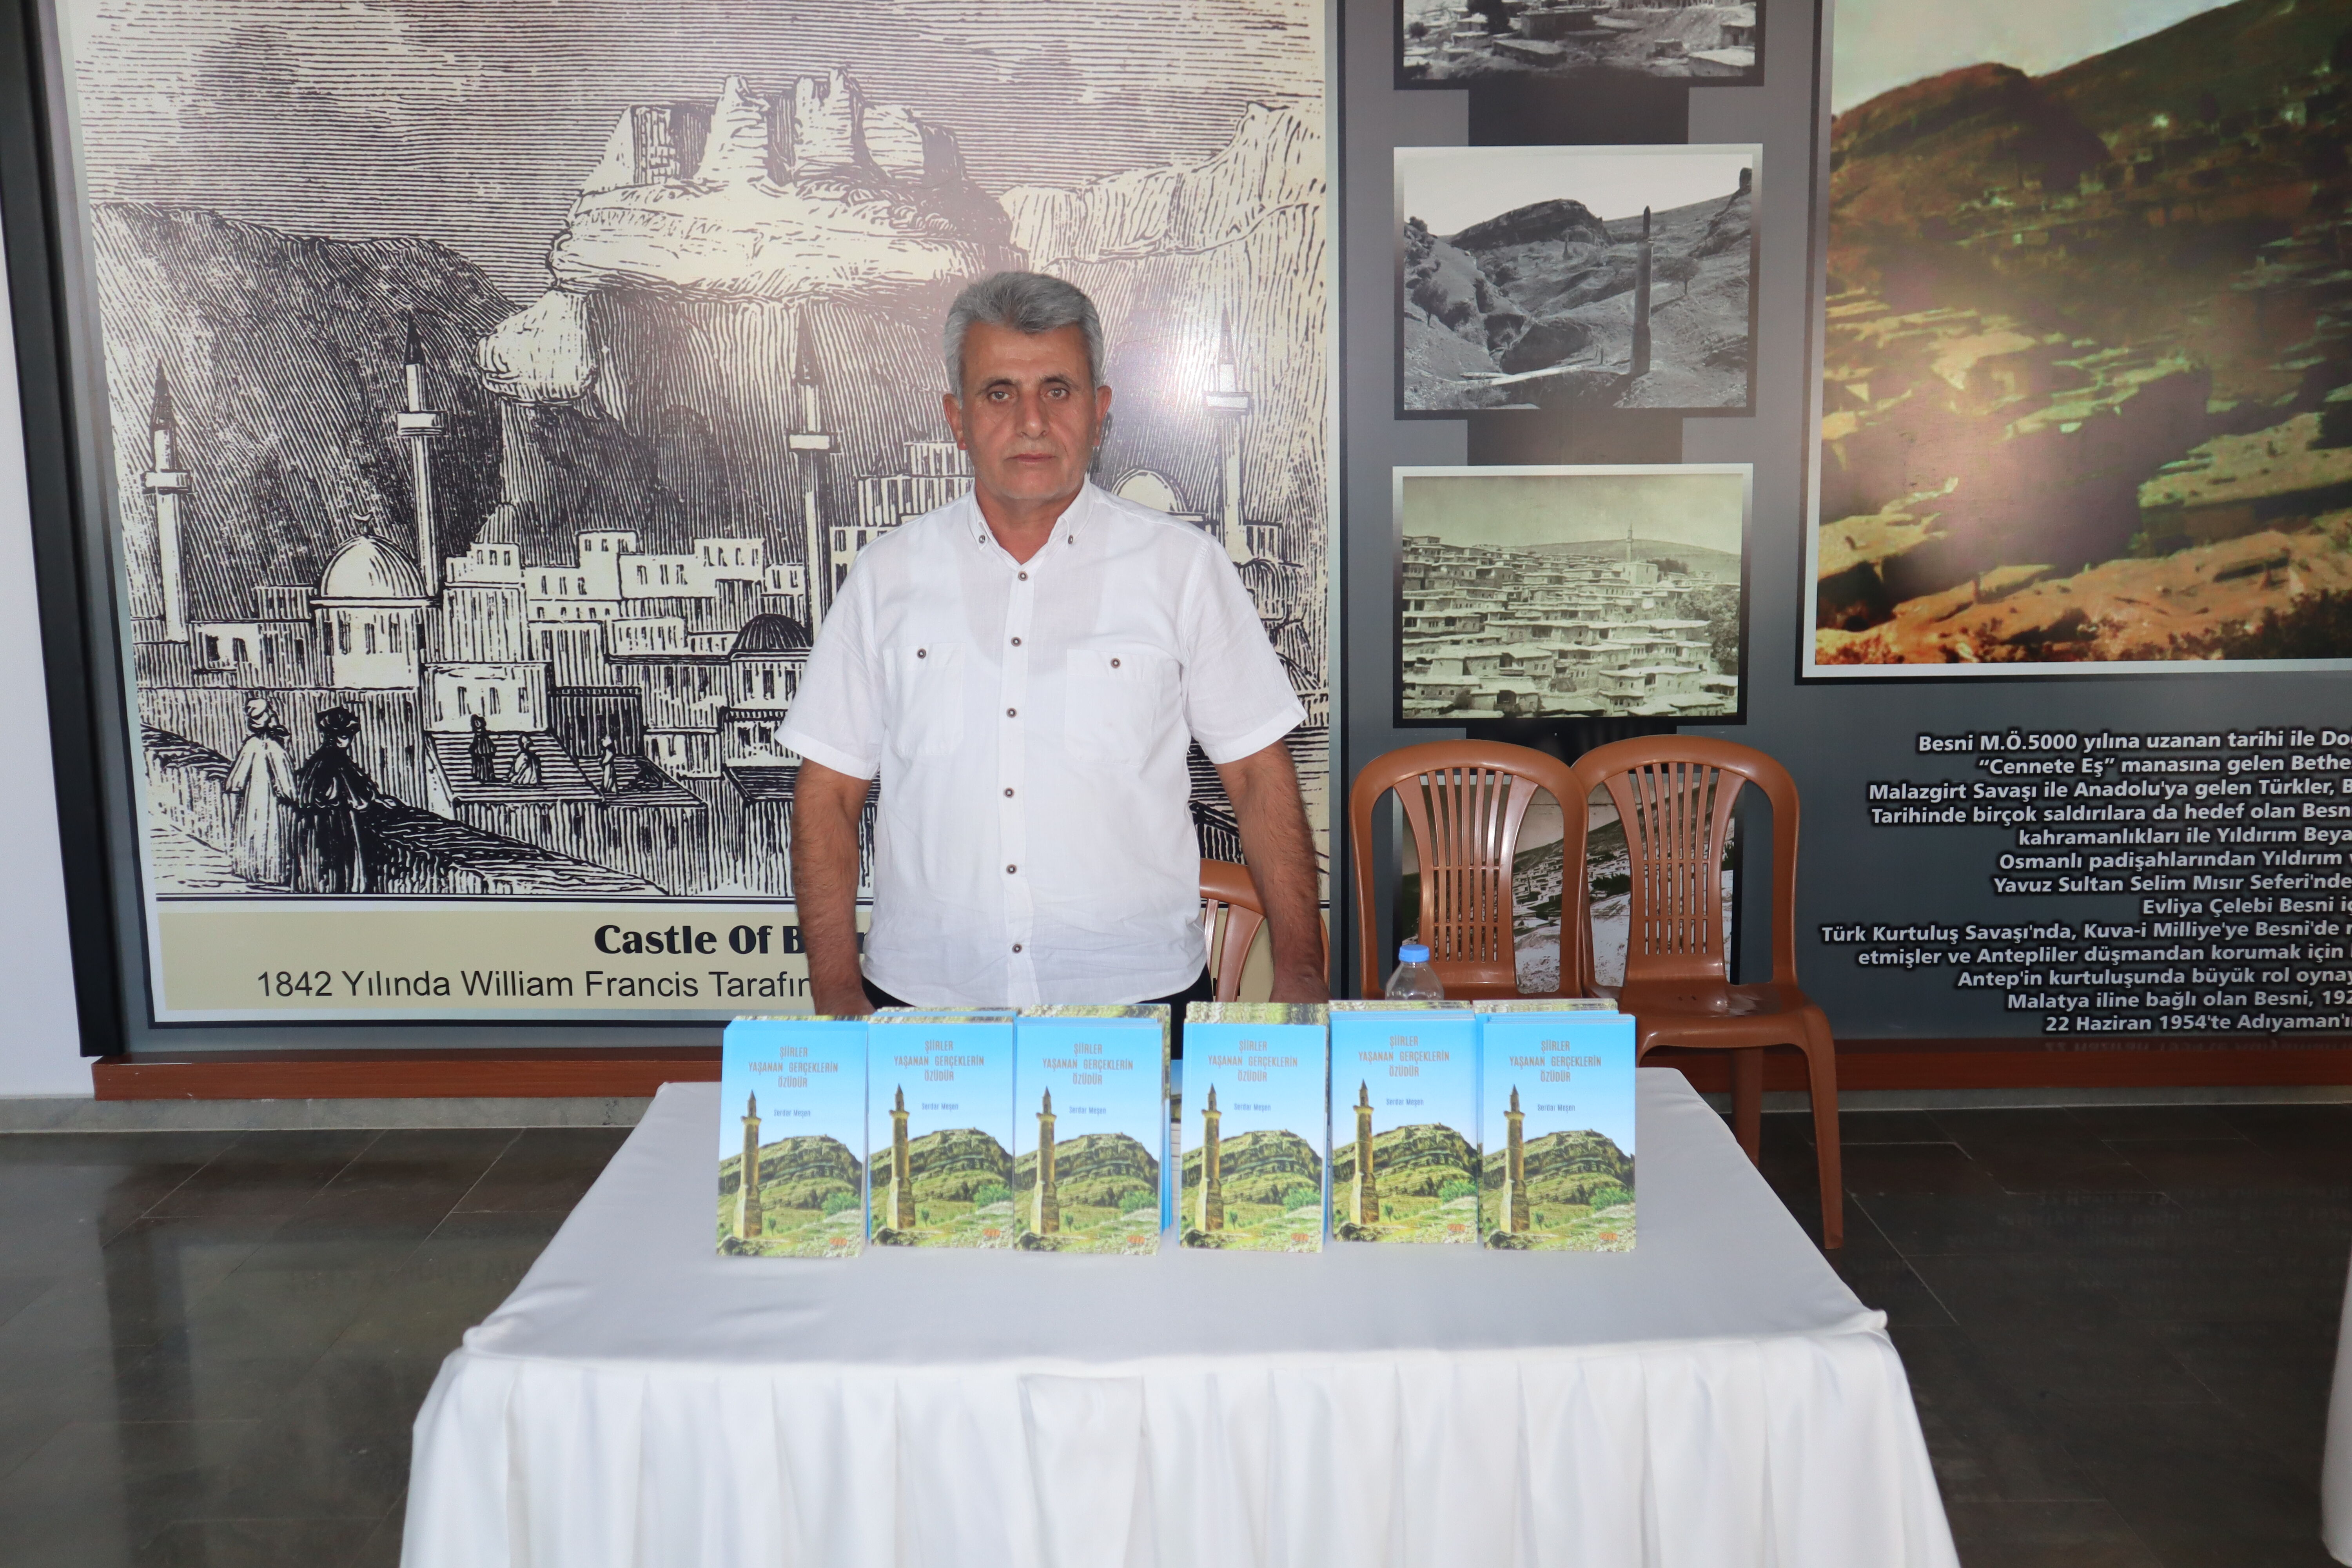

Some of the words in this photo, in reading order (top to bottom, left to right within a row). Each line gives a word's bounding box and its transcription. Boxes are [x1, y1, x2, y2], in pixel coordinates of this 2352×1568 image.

[1919, 735, 1973, 751] Besni
[1980, 730, 2077, 750] M.Ö.5000
[2084, 733, 2140, 753] yılına
[2147, 736, 2221, 748] uzanan
[2227, 730, 2283, 747] tarihi
[2291, 730, 2315, 746] ile
[2322, 731, 2352, 749] Do
[2122, 760, 2220, 772] manasına
[2227, 755, 2284, 775] gelen
[2291, 754, 2352, 771] Bethe
[1869, 783, 1967, 803] Malazgirt
[1973, 783, 2036, 802] Savaşı
[2044, 781, 2068, 797] ile
[2195, 779, 2251, 799] gelen
[2259, 778, 2334, 795] Türkler,
[1871, 807, 1966, 823] Tarihinde
[1973, 806, 2036, 826] birçok
[2044, 804, 2145, 821] saldırılara
[2152, 804, 2177, 820] da
[2185, 803, 2245, 819] hedef
[2251, 802, 2295, 818] olan
[2303, 803, 2352, 818] Besn
[2019, 828, 2179, 845] kahramanlıkları
[2187, 827, 2210, 843] ile
[2217, 826, 2296, 842] Yıldırım
[2000, 853, 2082, 869] Osmanlı
[2089, 851, 2255, 872] padişahlarından
[2262, 850, 2342, 865] Yıldırım
[1994, 878, 2052, 892] Yavuz
[2059, 876, 2123, 892] Sultan
[2131, 875, 2185, 891] Selim
[2193, 875, 2244, 890] Mısır
[2143, 898, 2202, 917] Evliya
[2210, 897, 2272, 917] Çelebi
[2280, 897, 2334, 912] Besni
[594, 925, 717, 955] Castle
[728, 925, 773, 954] Of
[1822, 926, 1866, 941] Türk
[1873, 925, 1958, 944] Kurtuluş
[2084, 922, 2146, 938] Kuva-i
[1859, 949, 1942, 968] etmişler
[1948, 952, 1971, 963] ve
[1977, 947, 2078, 966] Antepliler
[2085, 945, 2204, 965] düşmandan
[2212, 944, 2301, 959] korumak
[2308, 943, 2343, 963] için
[257, 970, 333, 997] 1842
[341, 970, 451, 996] Yılında
[460, 970, 573, 997] William
[586, 971, 699, 997] Francis
[2050, 968, 2185, 988] kurtuluşunda
[2192, 967, 2254, 987] büyük
[2263, 967, 2289, 982] rol
[2008, 993, 2089, 1012] Malatya
[2097, 992, 2139, 1007] iline
[2147, 991, 2196, 1010] bağlı
[2203, 991, 2247, 1006] olan
[2255, 990, 2313, 1007] Besni,
[2046, 1017, 2069, 1031] 22
[2077, 1015, 2151, 1030] Haziran
[2237, 1014, 2352, 1032] Adıyaman'ı
[894, 1056, 929, 1069] YAŞANAN
[1042, 1058, 1078, 1071] YAŞANAN
[1208, 1055, 1243, 1068] YAŞANAN
[1358, 1051, 1394, 1064] YAŞANAN
[1509, 1056, 1545, 1070] YAŞANAN
[748, 1062, 783, 1074] YAŞANAN
[924, 1070, 954, 1081] ÖZÜDÜR
[1238, 1070, 1267, 1082] ÖZÜDÜR
[1389, 1065, 1419, 1077] ÖZÜDÜR
[1540, 1071, 1571, 1082] ÖZÜDÜR
[778, 1076, 808, 1088] ÖZÜDÜR
[1073, 1073, 1103, 1085] ÖZÜDÜR
